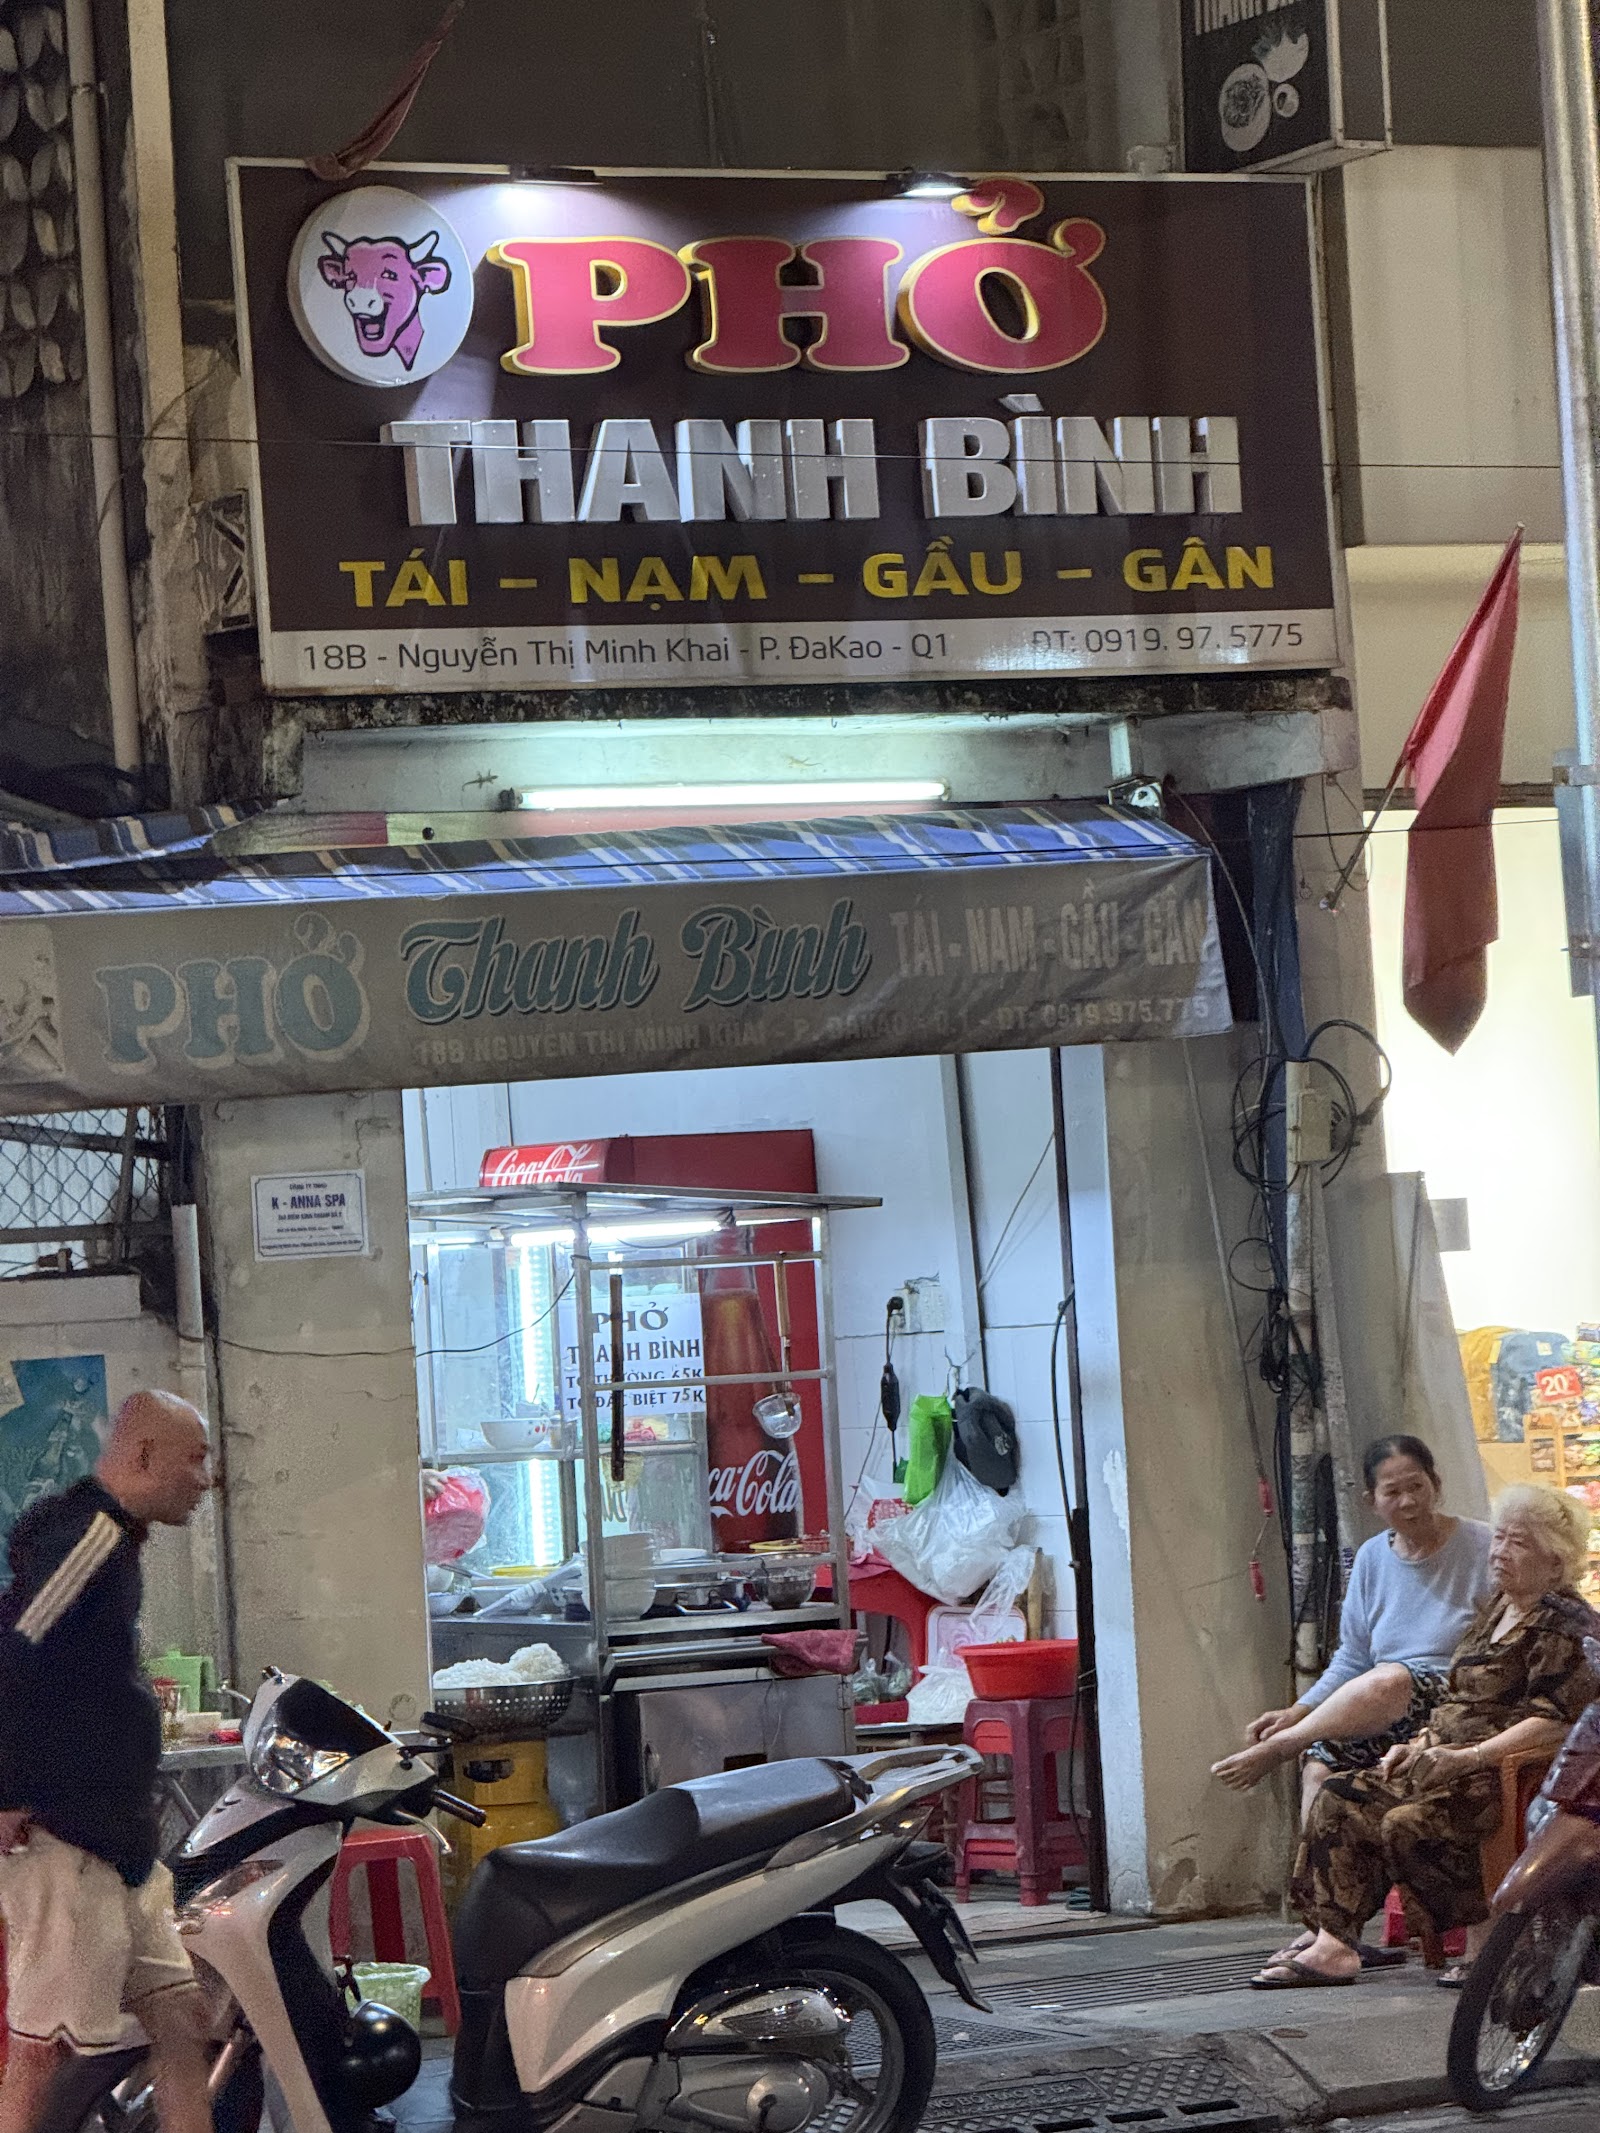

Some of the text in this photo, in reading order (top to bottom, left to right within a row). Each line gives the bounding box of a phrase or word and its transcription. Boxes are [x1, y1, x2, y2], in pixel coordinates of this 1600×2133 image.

[487, 176, 1107, 375] PHỞ
[380, 393, 1242, 526] THANH BÌNH
[340, 548, 469, 608] TÁI
[569, 554, 768, 611] NẠM
[303, 644, 367, 671] 18B
[399, 636, 518, 674] Nguyễn
[526, 639, 574, 670] Thị
[585, 637, 656, 665] Minh
[666, 636, 730, 663] Khai
[759, 636, 780, 661] P.
[788, 635, 883, 661] ĐaKao
[911, 633, 947, 660] Q1
[1085, 627, 1168, 653] 0919.
[1230, 623, 1303, 649] 5775
[95, 897, 872, 1075] PHỞ Thanh Bình
[290, 1195, 321, 1209] ANNA
[324, 1193, 346, 1207] SPA
[648, 1336, 701, 1361] BÌNH
[633, 1390, 667, 1408] BIỆT
[671, 1388, 705, 1404] 75K
